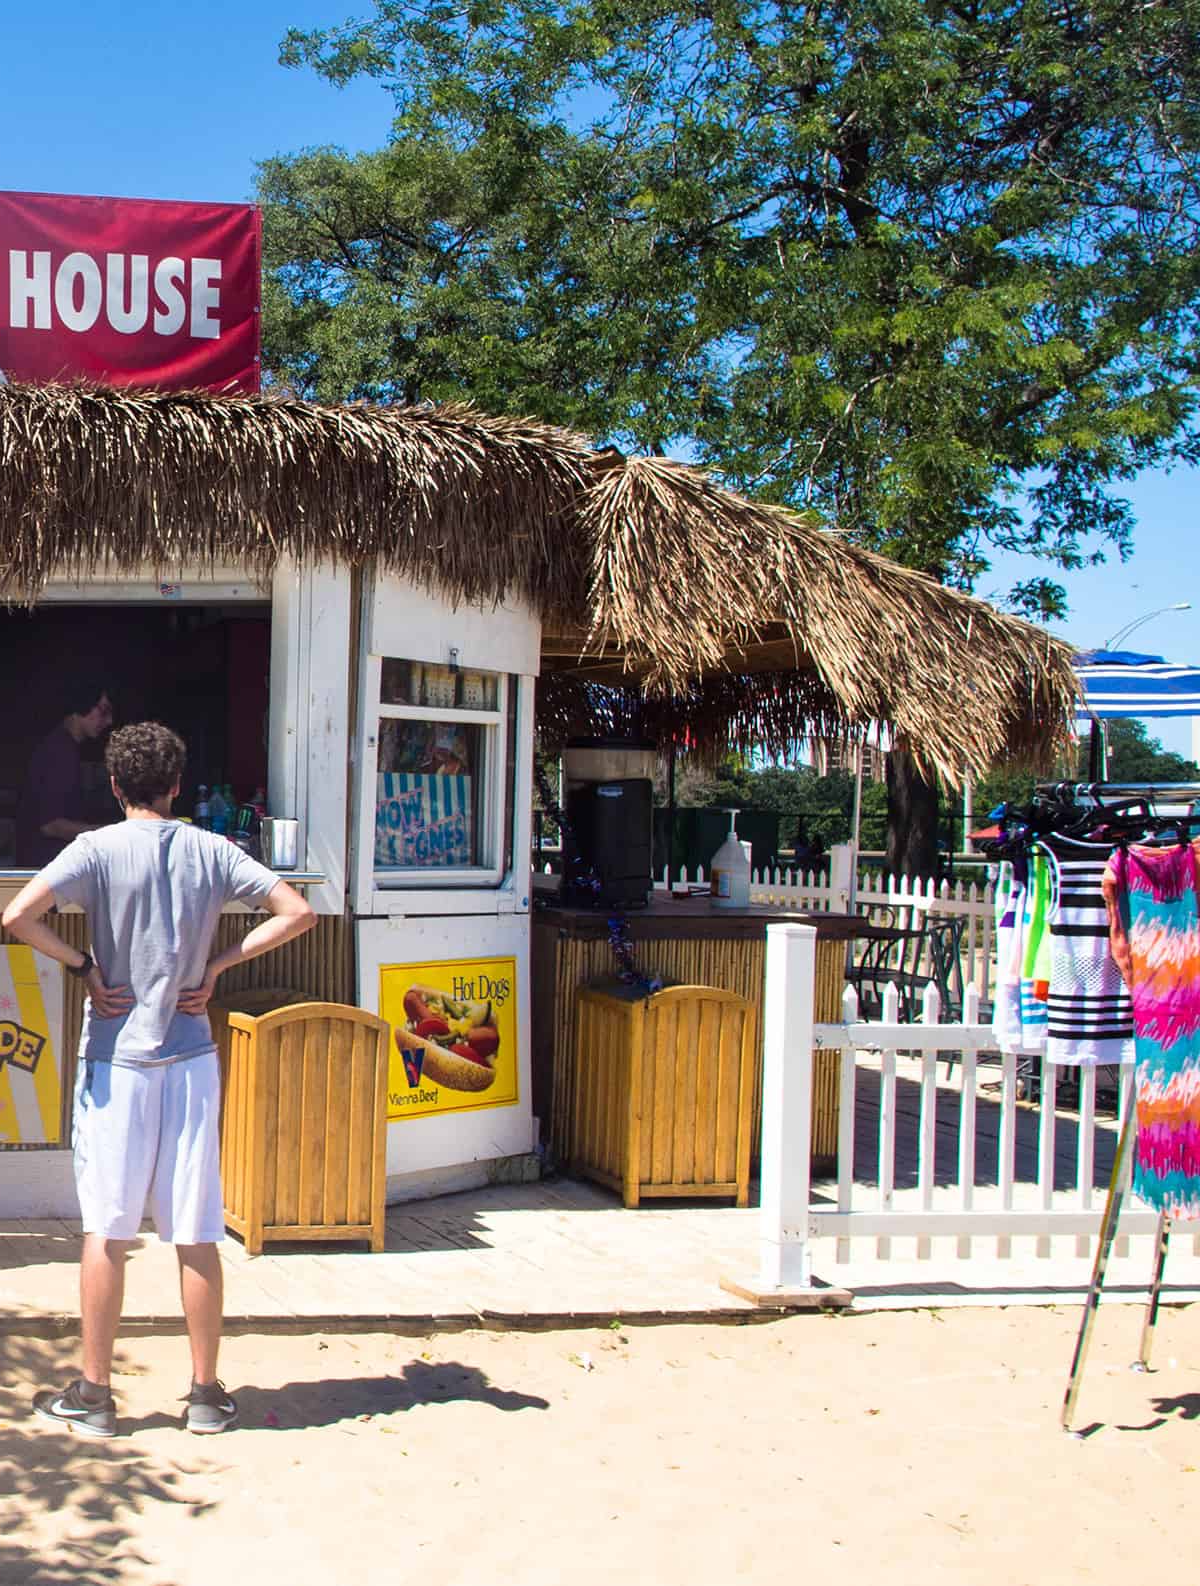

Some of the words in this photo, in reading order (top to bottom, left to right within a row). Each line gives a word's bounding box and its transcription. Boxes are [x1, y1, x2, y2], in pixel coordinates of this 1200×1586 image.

[8, 249, 222, 339] HOUSE
[452, 976, 476, 1002] Hot
[388, 1092, 418, 1106] Vienna
[419, 1087, 439, 1104] Beef
